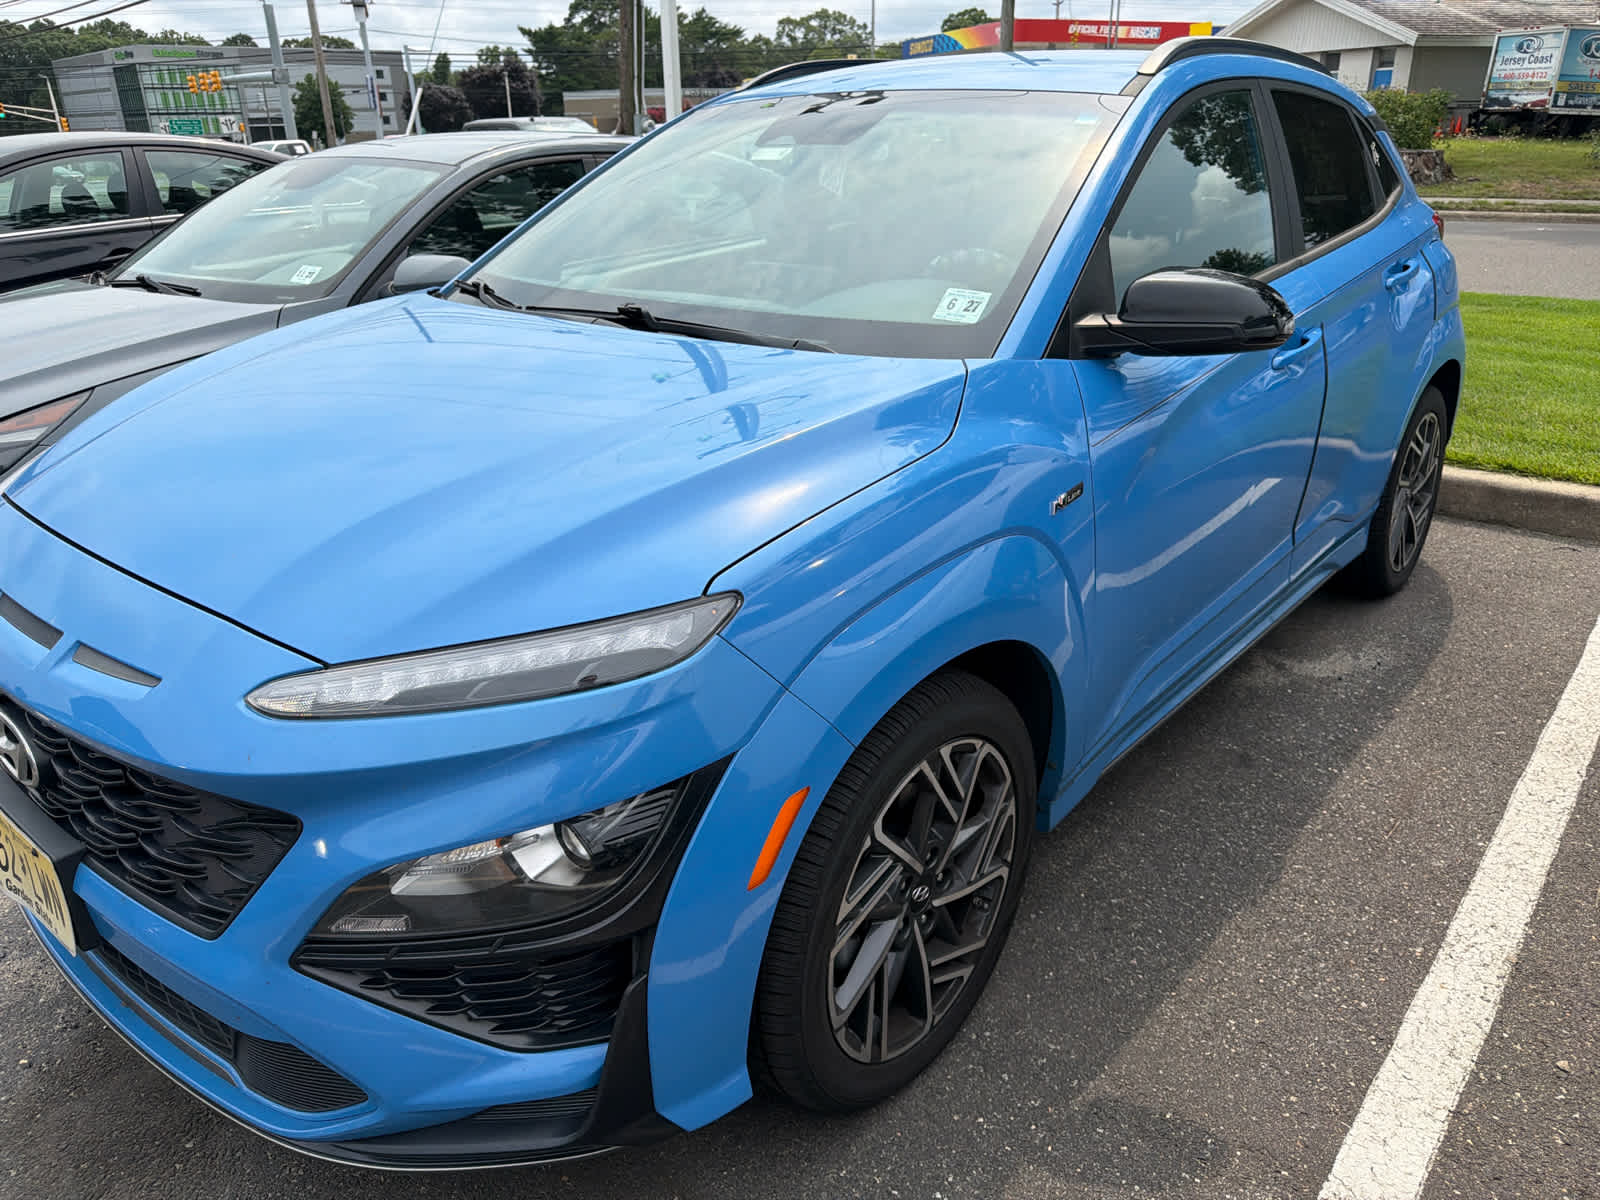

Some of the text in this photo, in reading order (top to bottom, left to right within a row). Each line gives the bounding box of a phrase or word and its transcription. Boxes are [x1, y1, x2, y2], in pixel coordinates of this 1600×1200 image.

[1500, 53, 1553, 67] Jersey Coast
[946, 298, 982, 313] 6 27
